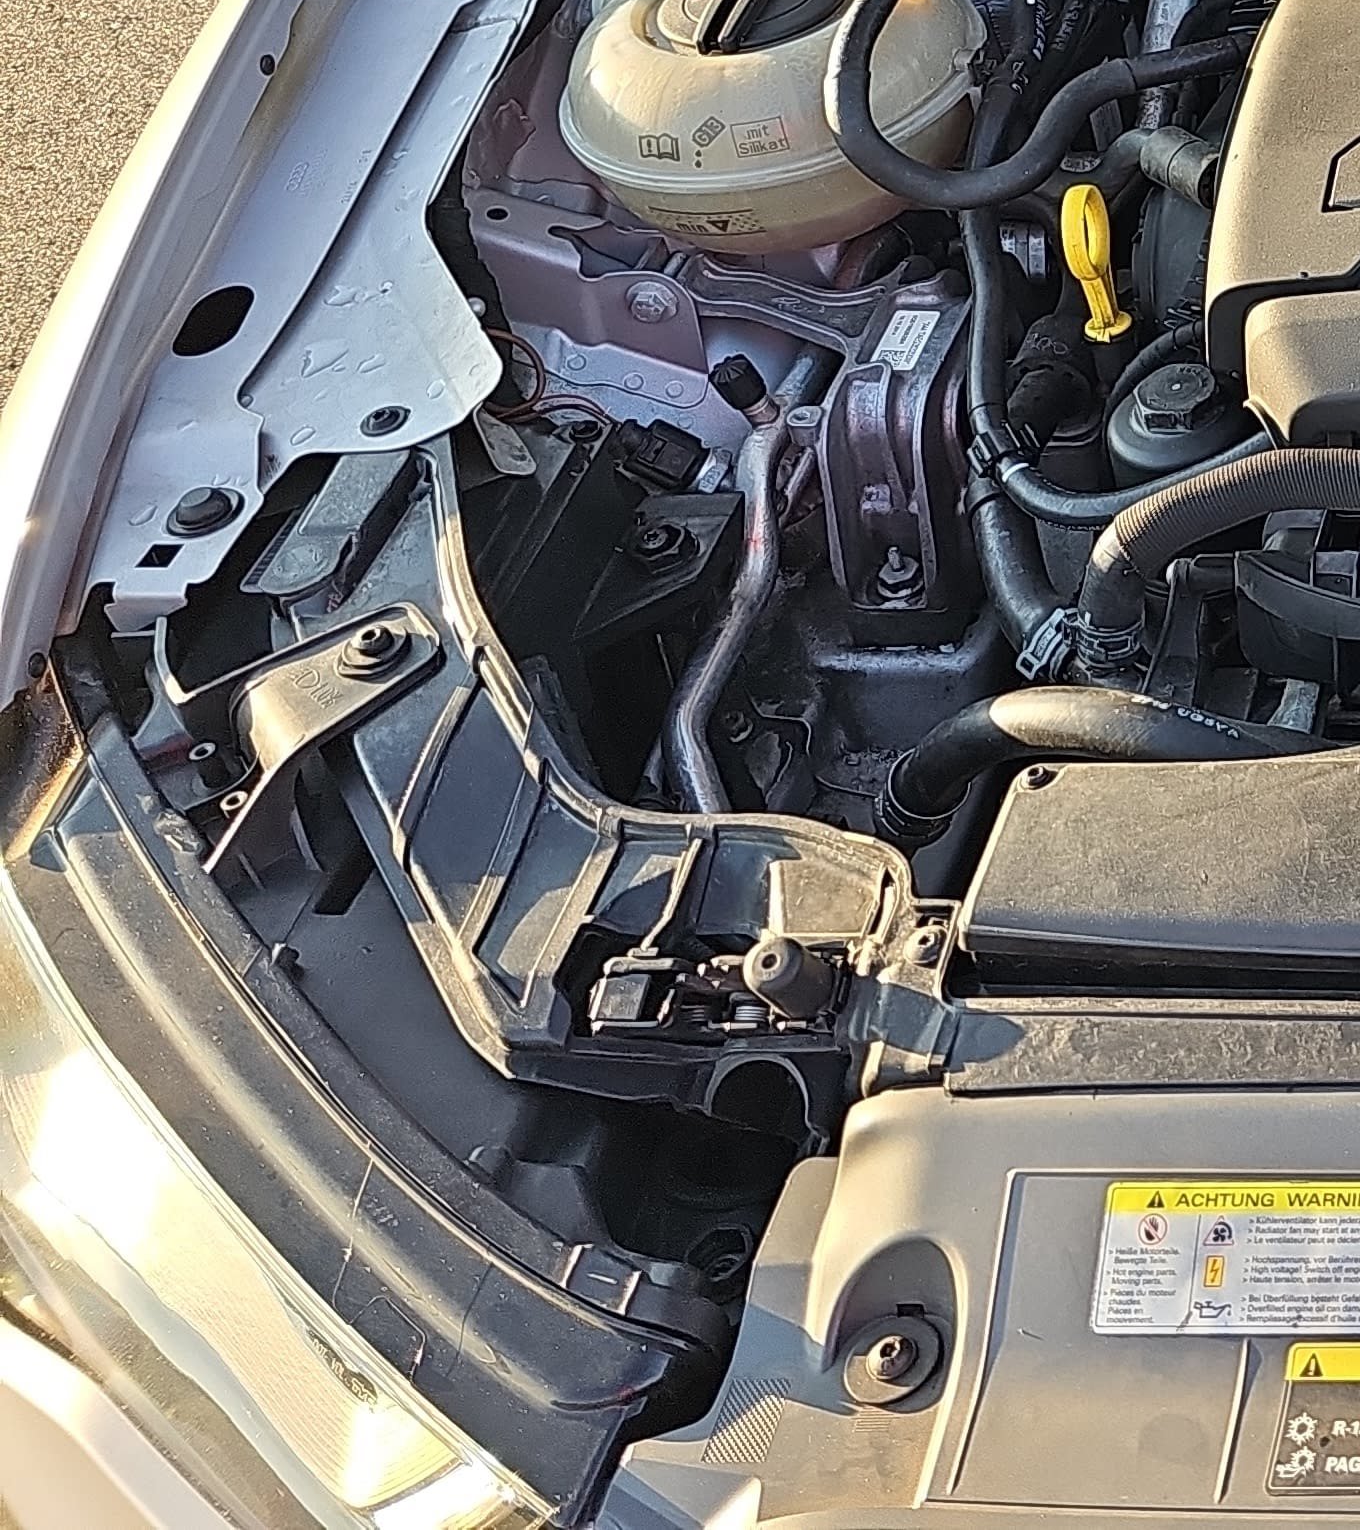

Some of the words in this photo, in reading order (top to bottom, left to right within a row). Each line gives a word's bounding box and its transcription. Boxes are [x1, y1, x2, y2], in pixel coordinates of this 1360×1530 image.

[745, 125, 769, 139] mit
[738, 139, 785, 155] Silikat
[1175, 1191, 1275, 1208] ACHTUNG
[1321, 1226, 1339, 1234] start
[1253, 1235, 1263, 1244] Le
[1306, 1237, 1324, 1245] peut
[1250, 1265, 1269, 1275] High
[1303, 1264, 1331, 1274] Switch
[1331, 1265, 1343, 1273] off
[1248, 1275, 1272, 1283] Haute
[1333, 1274, 1341, 1283] le
[1248, 1293, 1261, 1302] Bei
[1310, 1294, 1339, 1304] besteht
[1247, 1303, 1285, 1312] Overfilled
[1286, 1305, 1313, 1313] engine
[1314, 1304, 1325, 1312] oil
